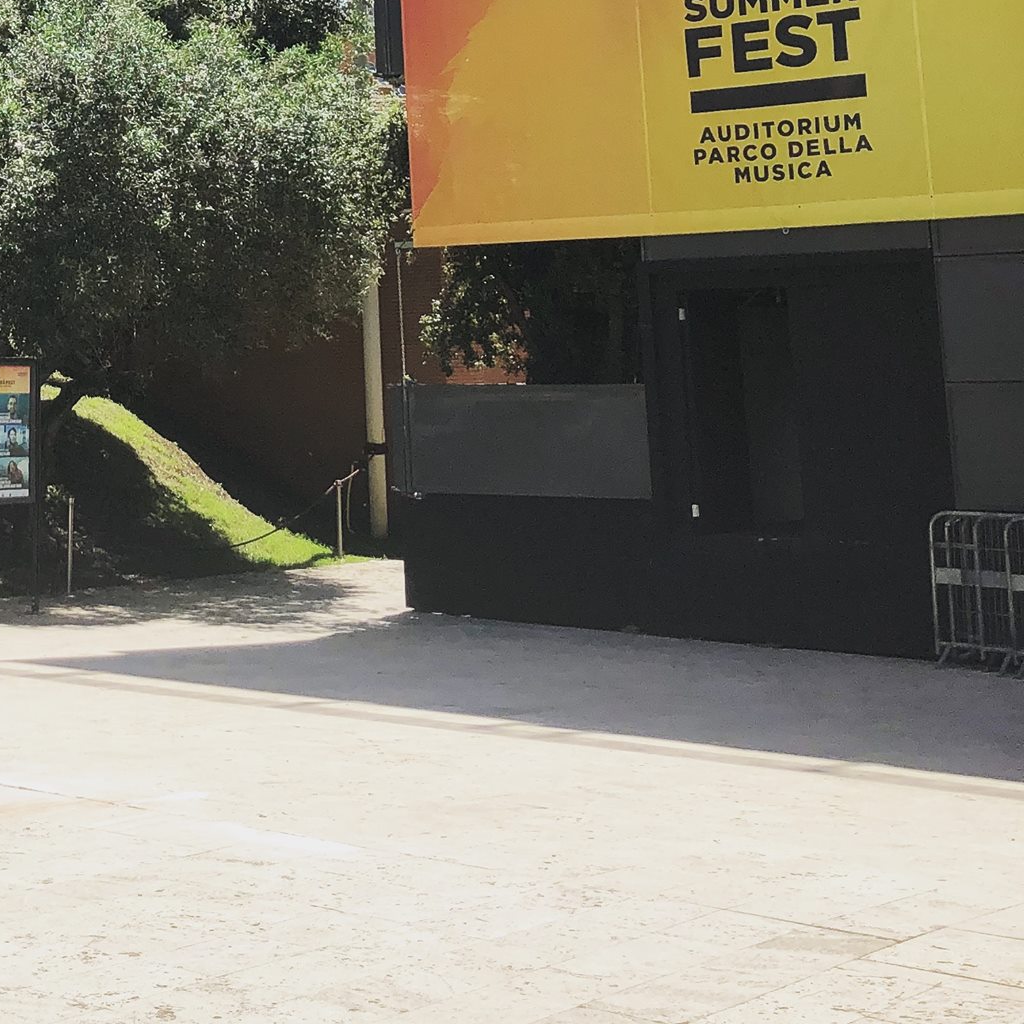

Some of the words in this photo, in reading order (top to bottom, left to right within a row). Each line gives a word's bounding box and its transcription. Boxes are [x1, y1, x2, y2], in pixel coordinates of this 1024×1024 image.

[684, 6, 861, 79] FEST
[699, 112, 862, 144] AUDITORIUM
[693, 143, 777, 166] PARCO
[787, 134, 873, 158] DELLA
[734, 160, 833, 184] MUSICA
